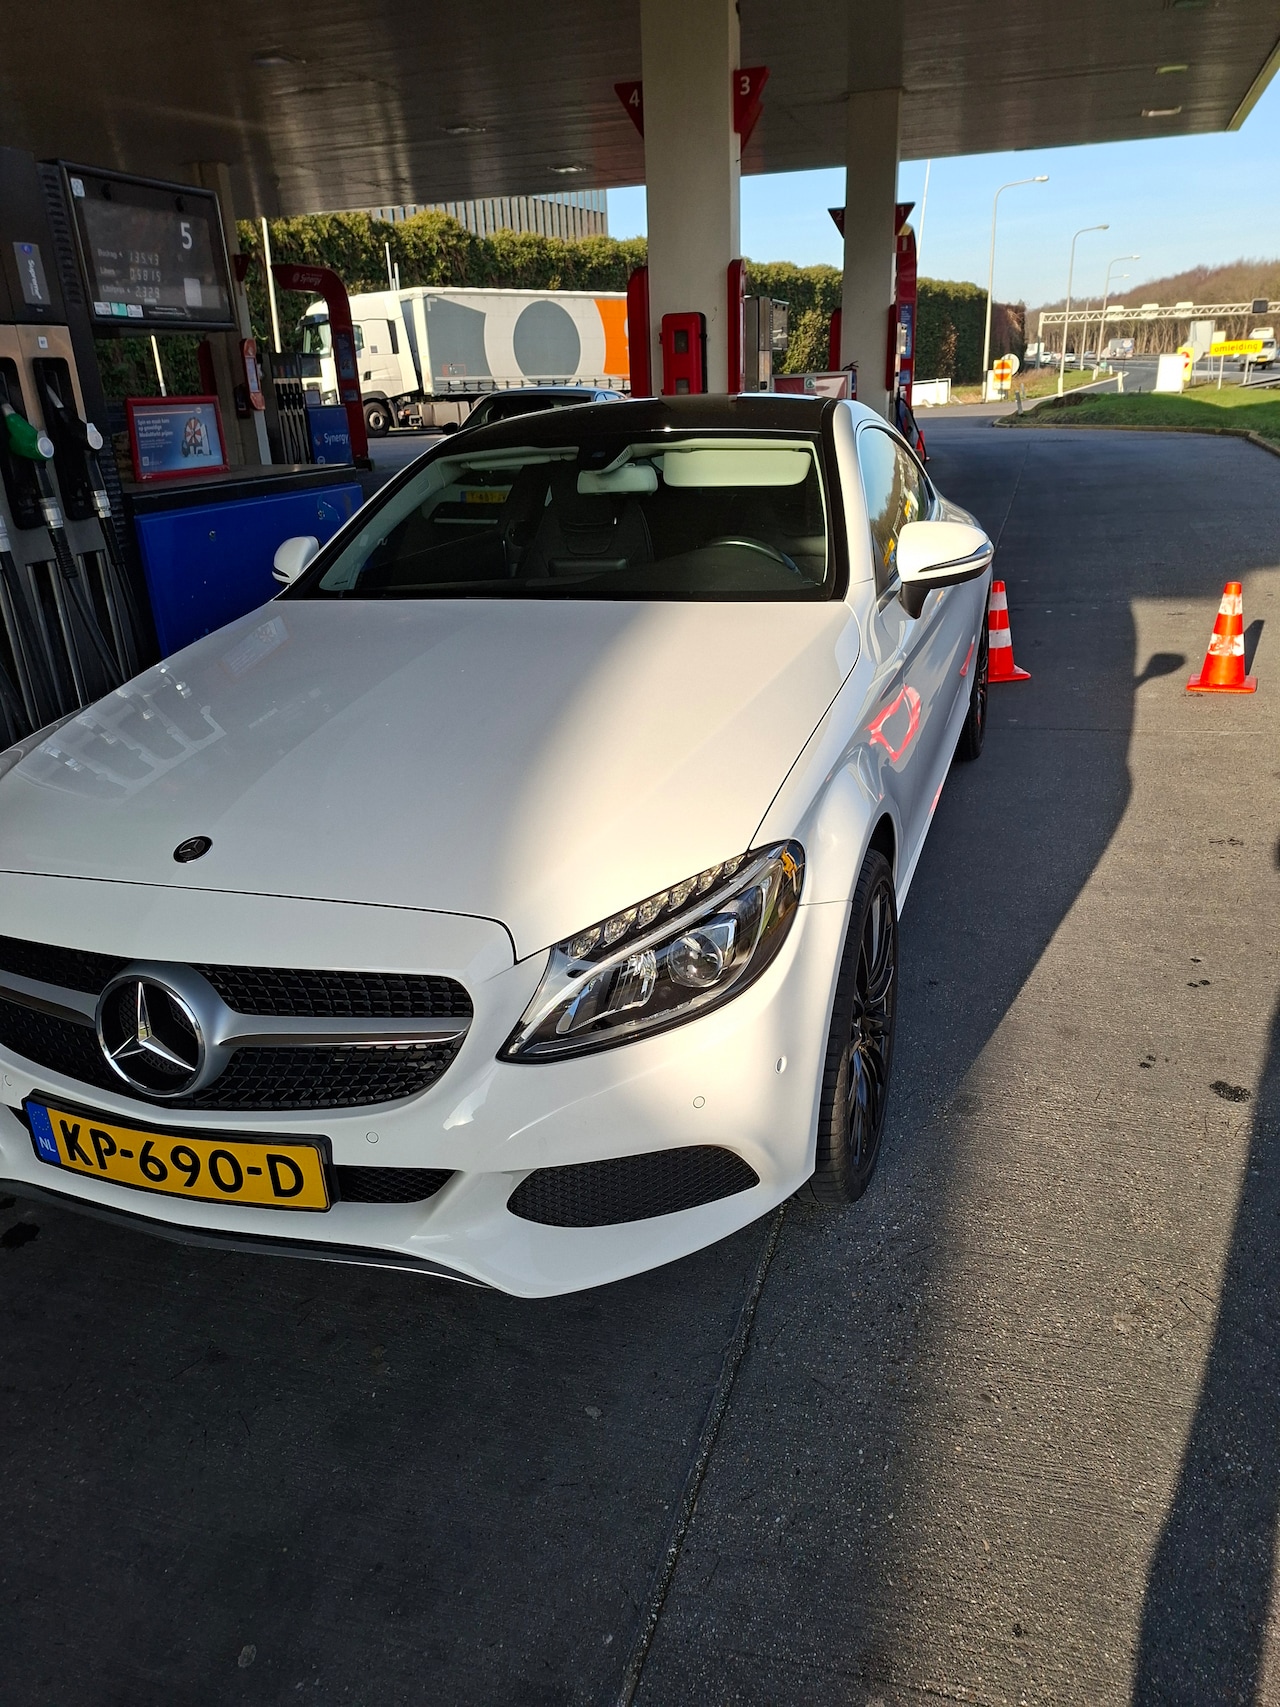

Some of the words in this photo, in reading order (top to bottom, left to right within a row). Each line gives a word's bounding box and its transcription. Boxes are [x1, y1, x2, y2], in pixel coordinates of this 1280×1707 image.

[739, 76, 750, 95] 3
[628, 89, 639, 107] 4
[835, 211, 843, 221] 2
[180, 221, 193, 250] 5
[300, 274, 323, 286] Synergy
[1214, 343, 1258, 353] omleiding
[323, 432, 349, 446] Synergy
[39, 1136, 56, 1153] NL
[58, 1119, 305, 1198] KP-690-D
